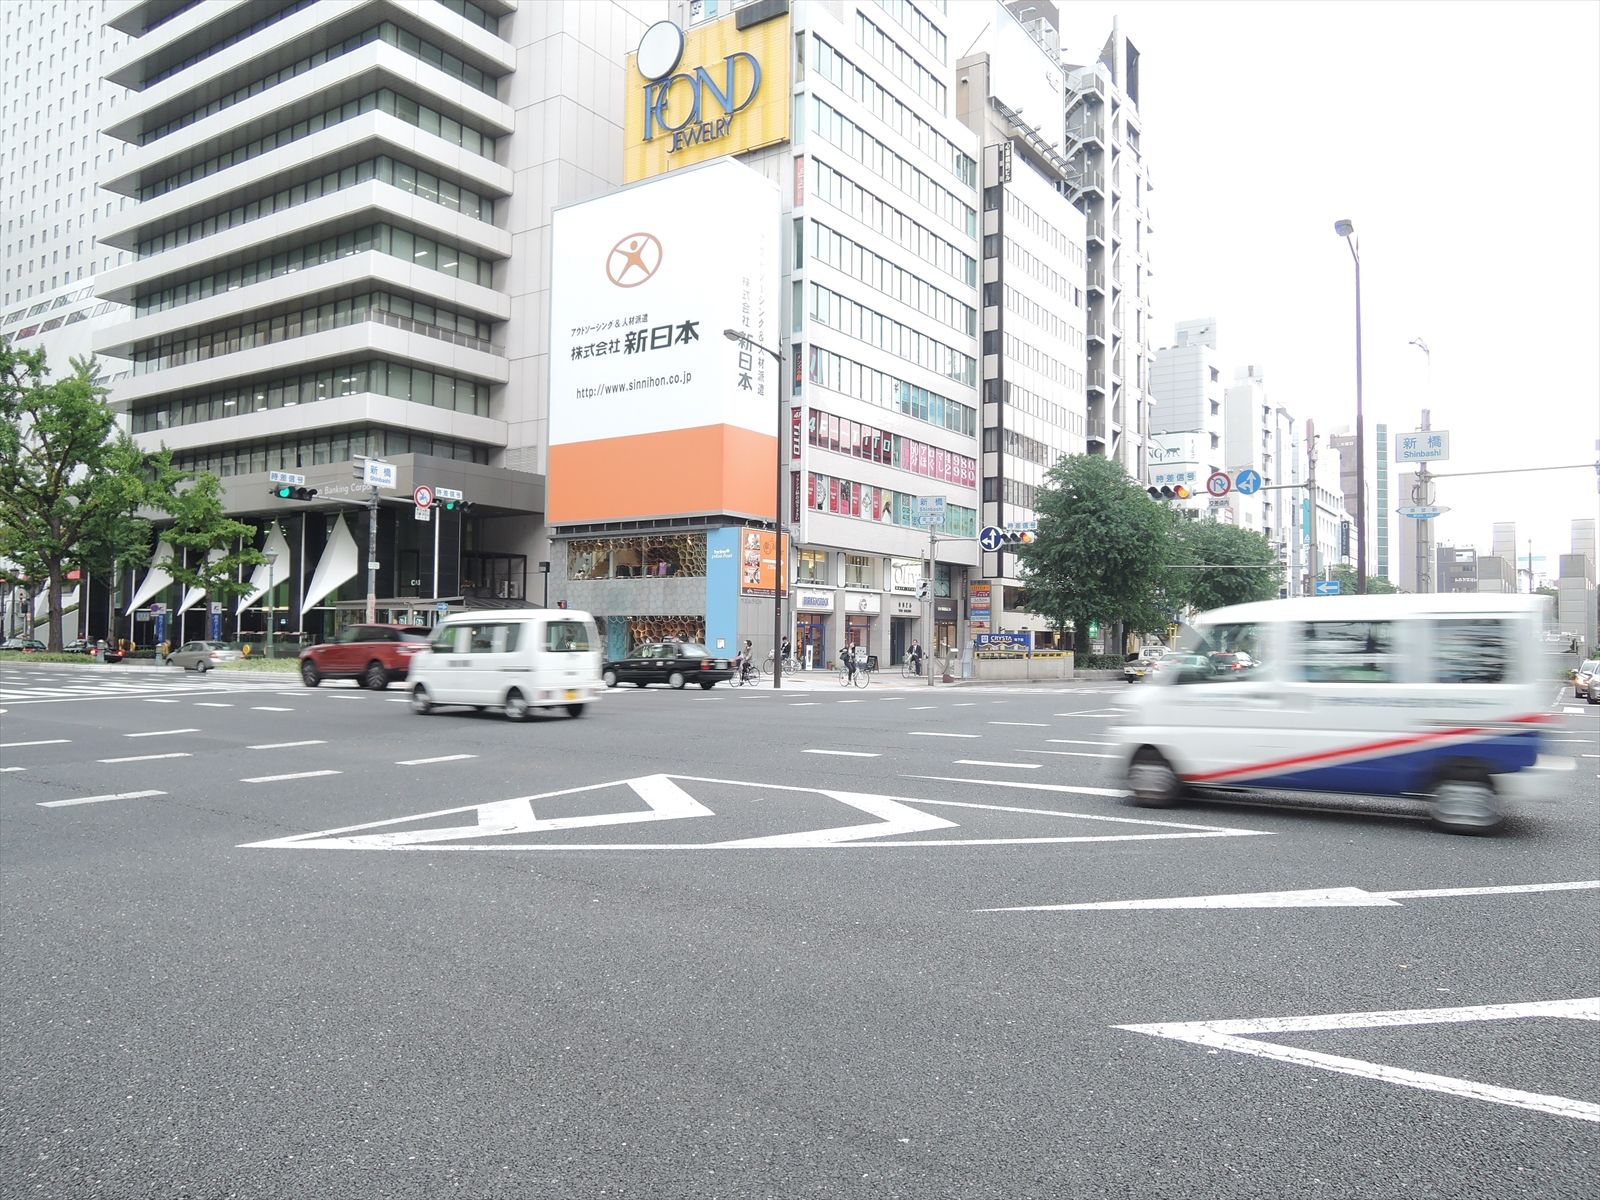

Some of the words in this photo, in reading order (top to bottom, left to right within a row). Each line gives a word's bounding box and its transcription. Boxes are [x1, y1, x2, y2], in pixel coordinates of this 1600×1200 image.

[643, 52, 762, 141] FOND
[667, 114, 734, 153] JEWELRY
[576, 371, 692, 399] http://www.sinnihon.co.jp
[1403, 436, 1441, 449] 新橋
[1404, 450, 1441, 458] Shinbashi
[1156, 472, 1195, 482] 時差信号
[325, 486, 348, 495] Banking
